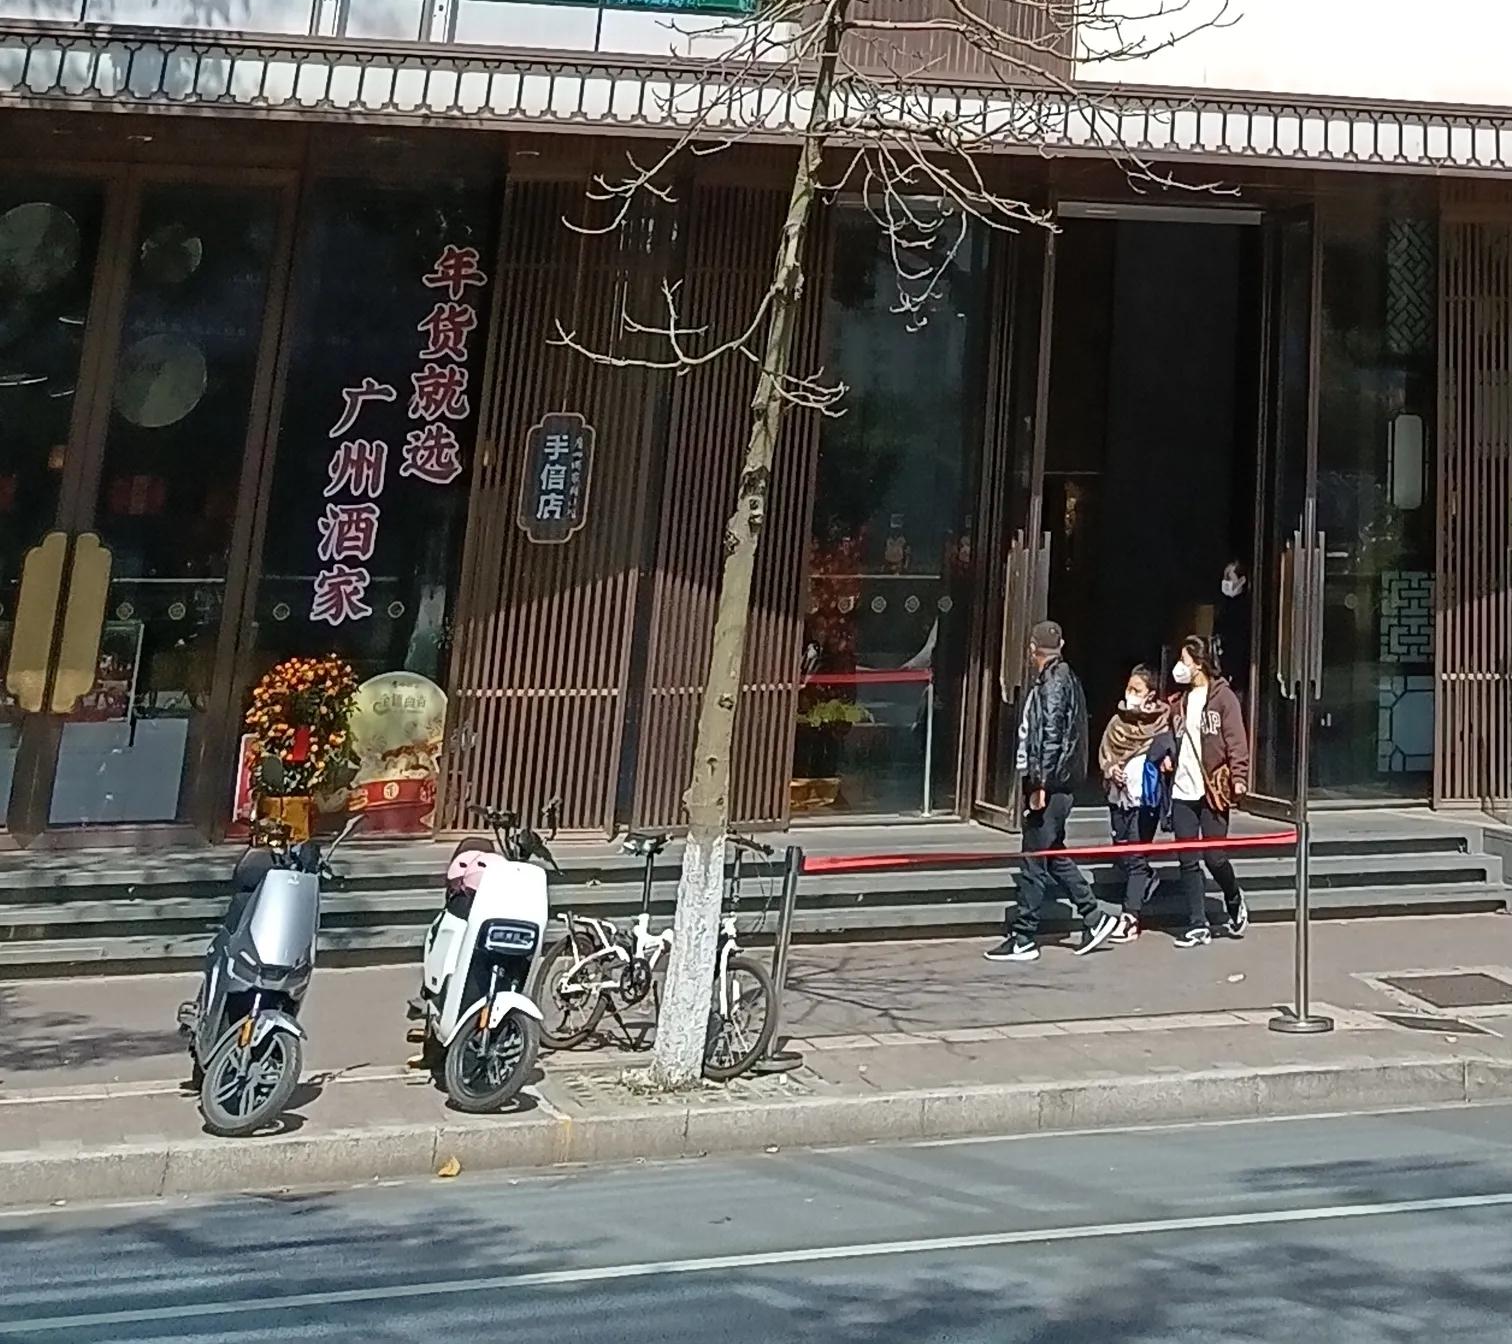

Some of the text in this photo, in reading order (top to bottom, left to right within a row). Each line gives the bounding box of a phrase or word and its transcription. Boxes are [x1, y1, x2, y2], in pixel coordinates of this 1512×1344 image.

[400, 244, 487, 485] 年货就选
[536, 434, 570, 520] 手信店
[309, 377, 397, 627] 广州酒家
